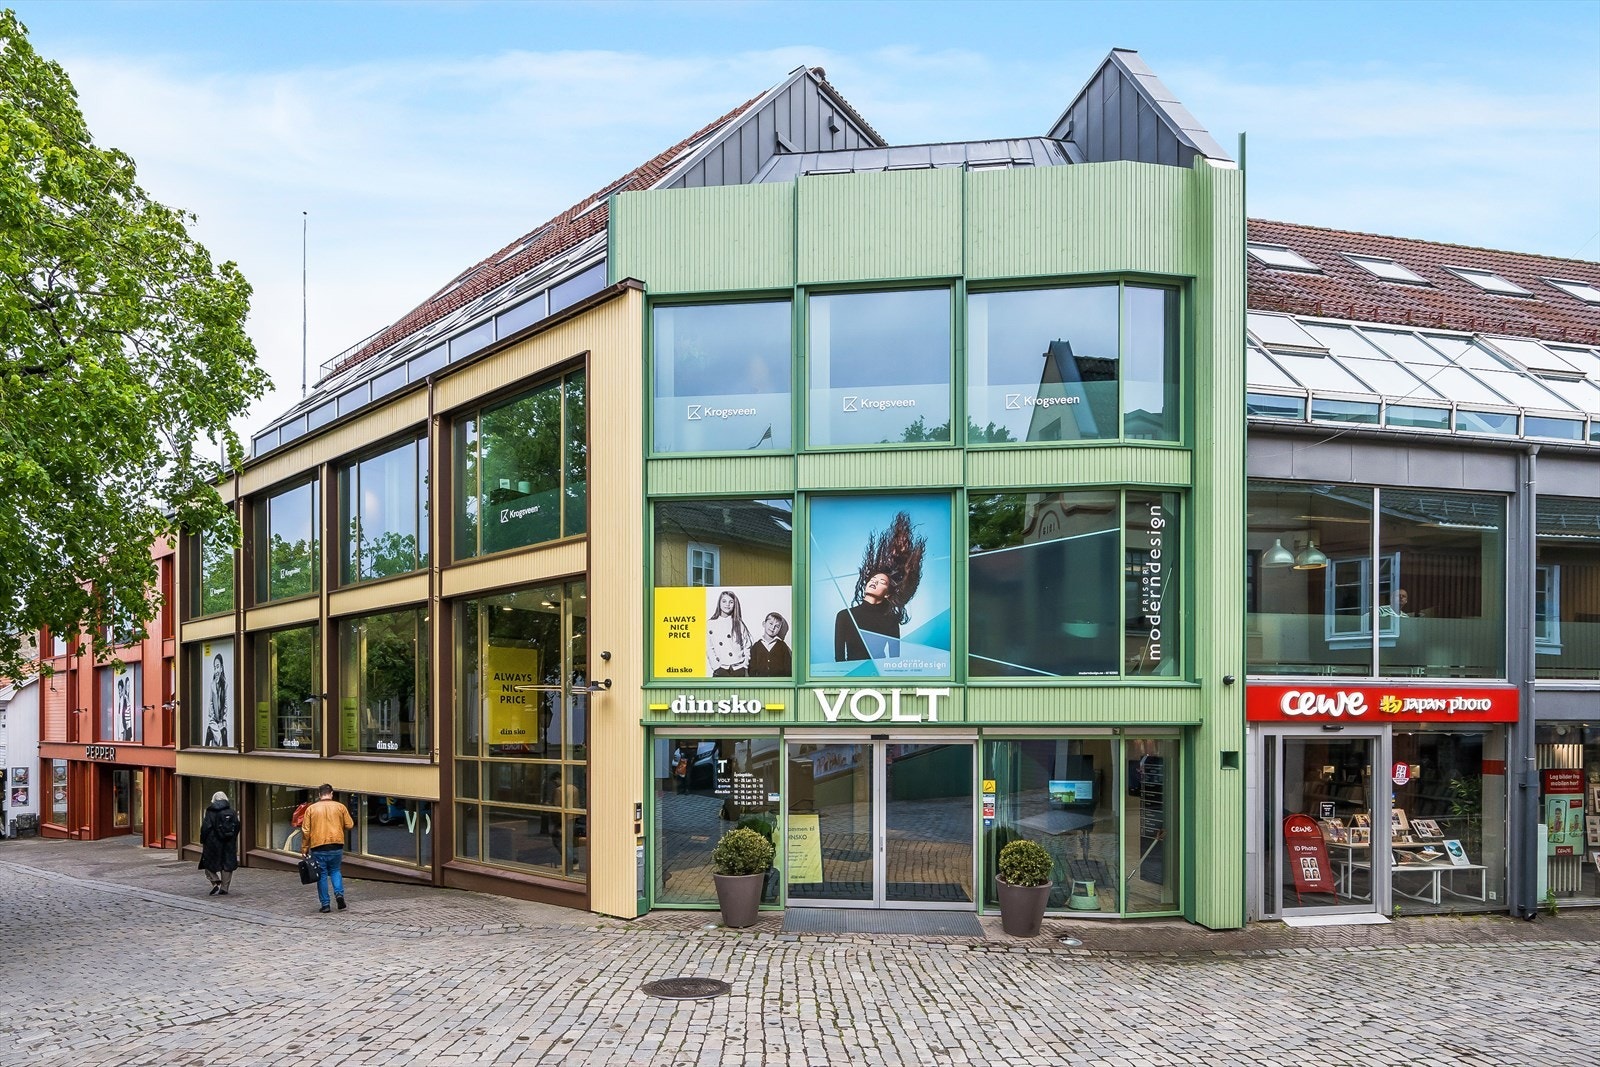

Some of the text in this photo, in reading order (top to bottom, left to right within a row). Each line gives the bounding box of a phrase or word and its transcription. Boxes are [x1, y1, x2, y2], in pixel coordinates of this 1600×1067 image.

[861, 398, 916, 411] Krogsveen
[1024, 395, 1080, 408] Krogsveen
[704, 407, 757, 419] Krogsveen
[509, 505, 539, 519] Krogsveen
[1146, 505, 1165, 660] moderndesign
[883, 661, 946, 670] moderndesign
[493, 672, 532, 682] ALWAYS
[500, 695, 526, 704] PRICE
[671, 694, 762, 714] din sko
[812, 687, 950, 723] VOLT
[376, 740, 399, 750] din sko
[86, 746, 116, 761] PEPPER
